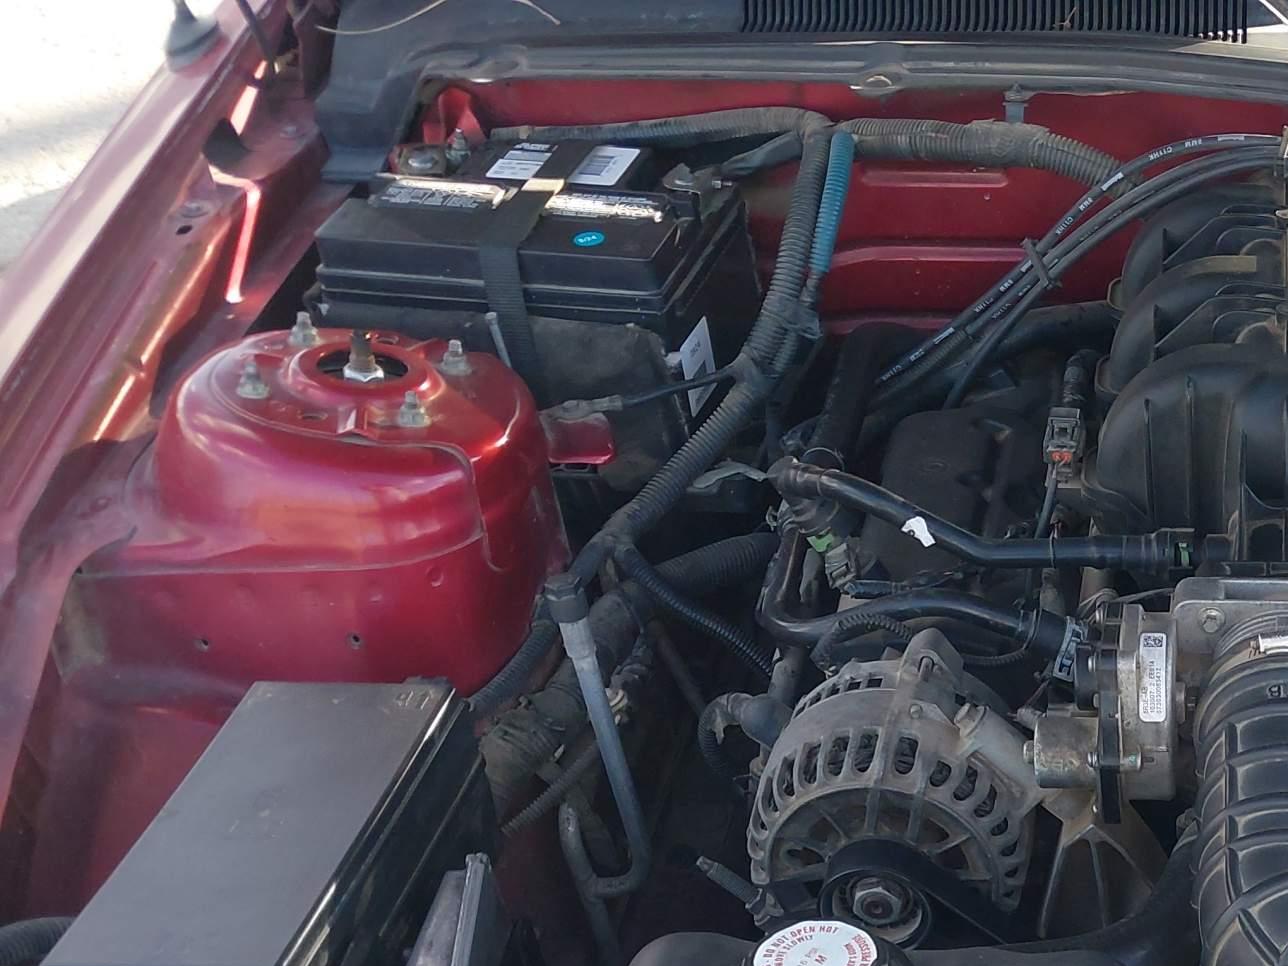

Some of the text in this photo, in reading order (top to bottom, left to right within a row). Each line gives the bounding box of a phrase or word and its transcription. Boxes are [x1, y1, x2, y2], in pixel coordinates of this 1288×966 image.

[763, 949, 775, 958] DO
[771, 935, 791, 948] NOT
[790, 925, 816, 938] OPEN
[819, 925, 840, 934] HOT
[782, 935, 814, 952] SLOWLY
